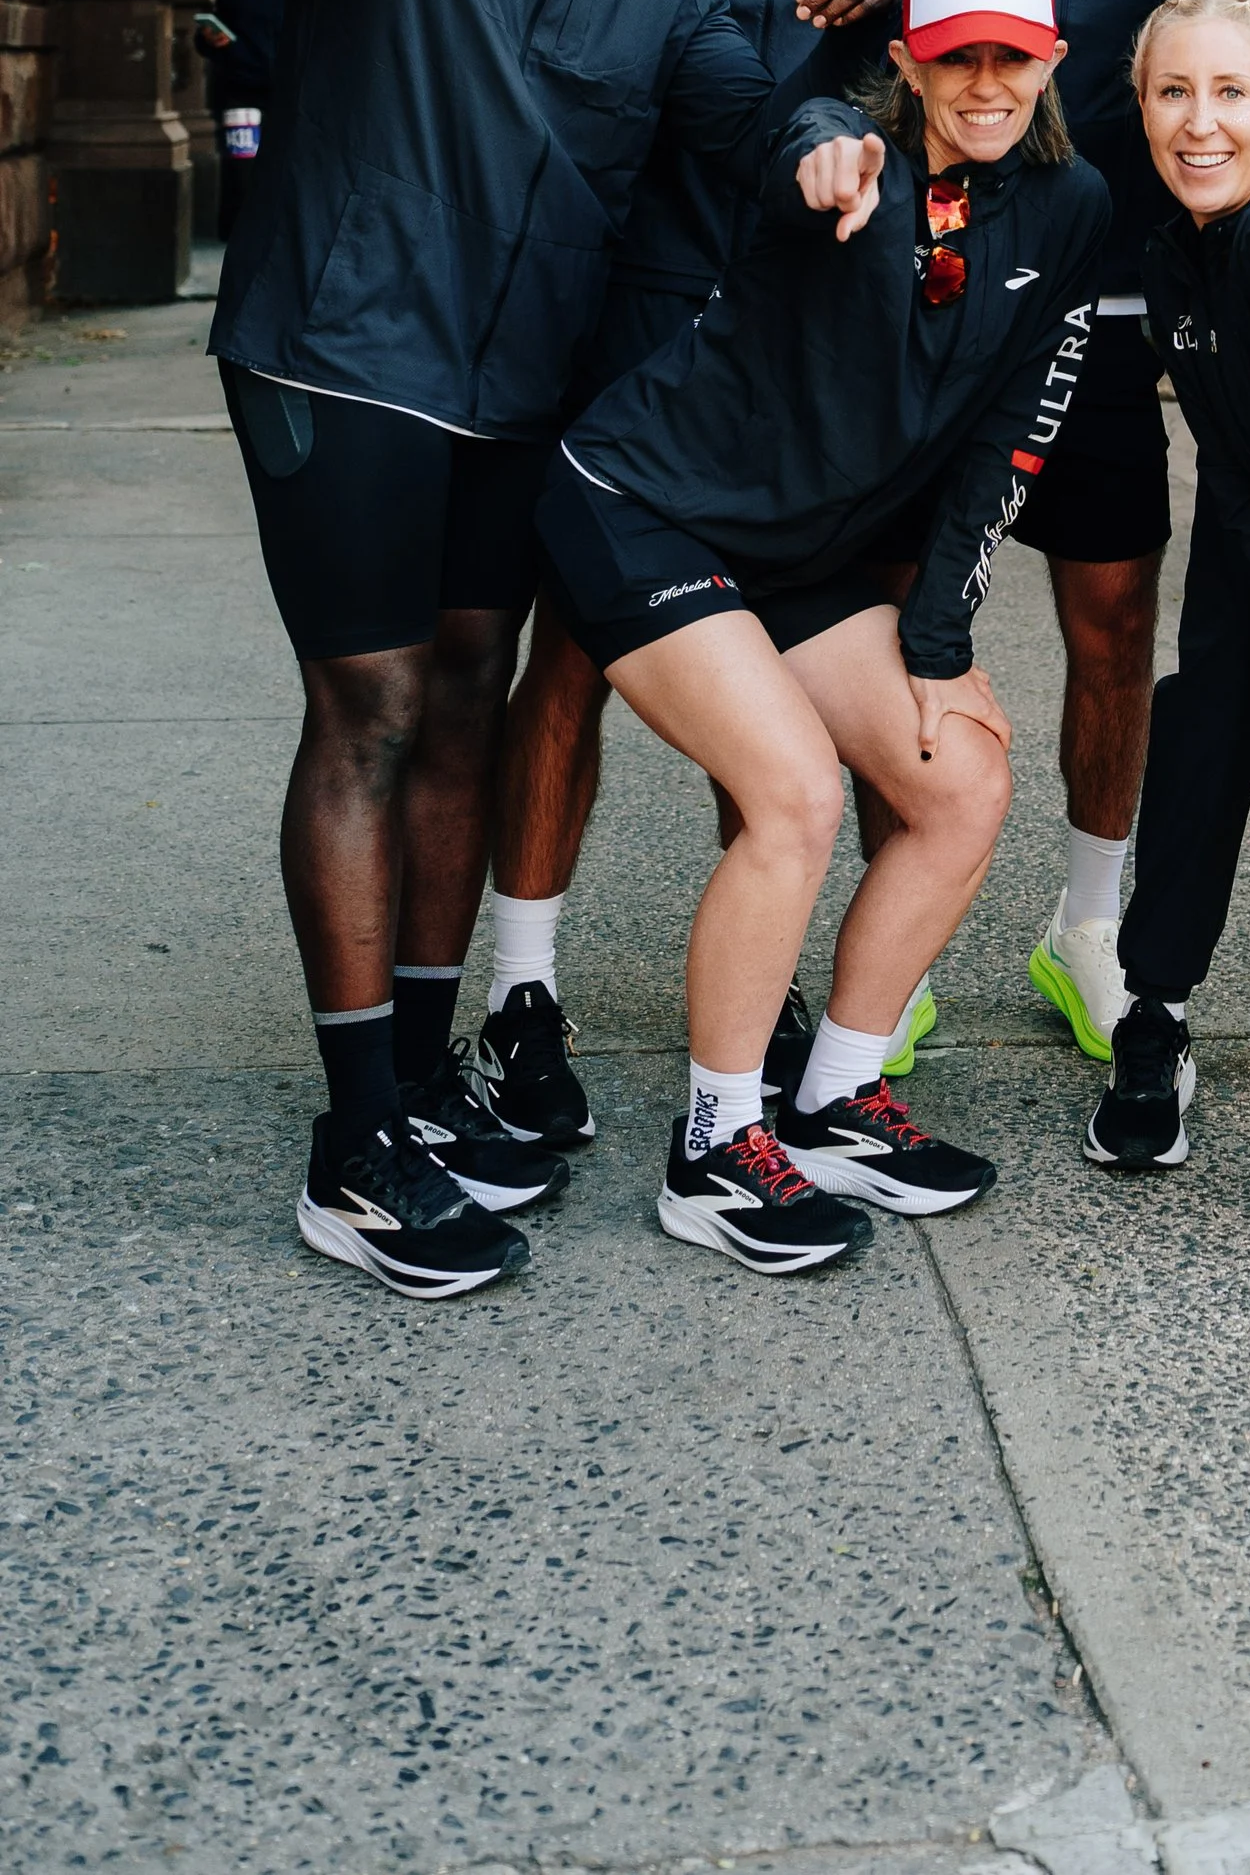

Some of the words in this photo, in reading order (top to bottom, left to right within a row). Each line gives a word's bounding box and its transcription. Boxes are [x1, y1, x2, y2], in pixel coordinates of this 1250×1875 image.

[1028, 303, 1092, 444] ULTRA
[648, 577, 712, 607] Michelob
[689, 1087, 719, 1153] BROOKS
[423, 1124, 449, 1139] BROOKS
[861, 1137, 885, 1151] BROOKS
[734, 1188, 756, 1205] BROOKS
[369, 1207, 393, 1226] BROOKS
